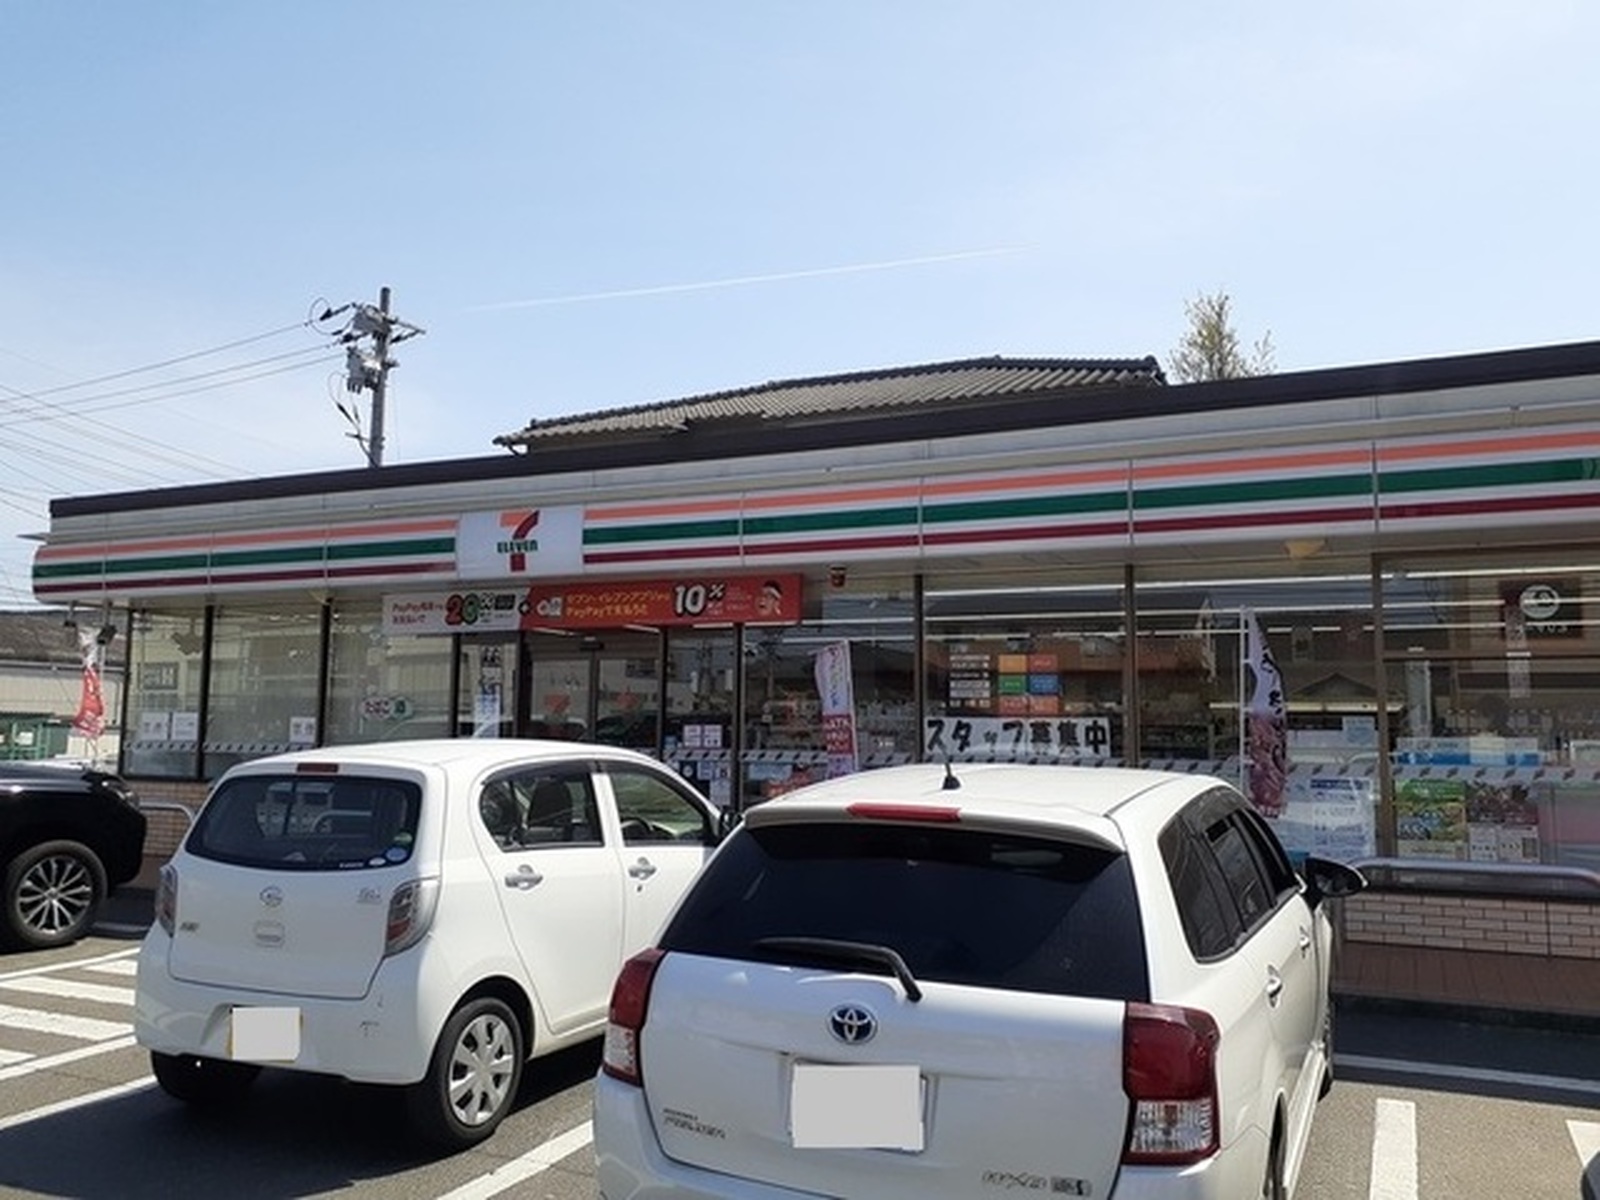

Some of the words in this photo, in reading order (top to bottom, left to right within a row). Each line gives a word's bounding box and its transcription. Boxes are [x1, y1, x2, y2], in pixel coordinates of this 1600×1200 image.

[926, 719, 1108, 756] スタッフ募集中
